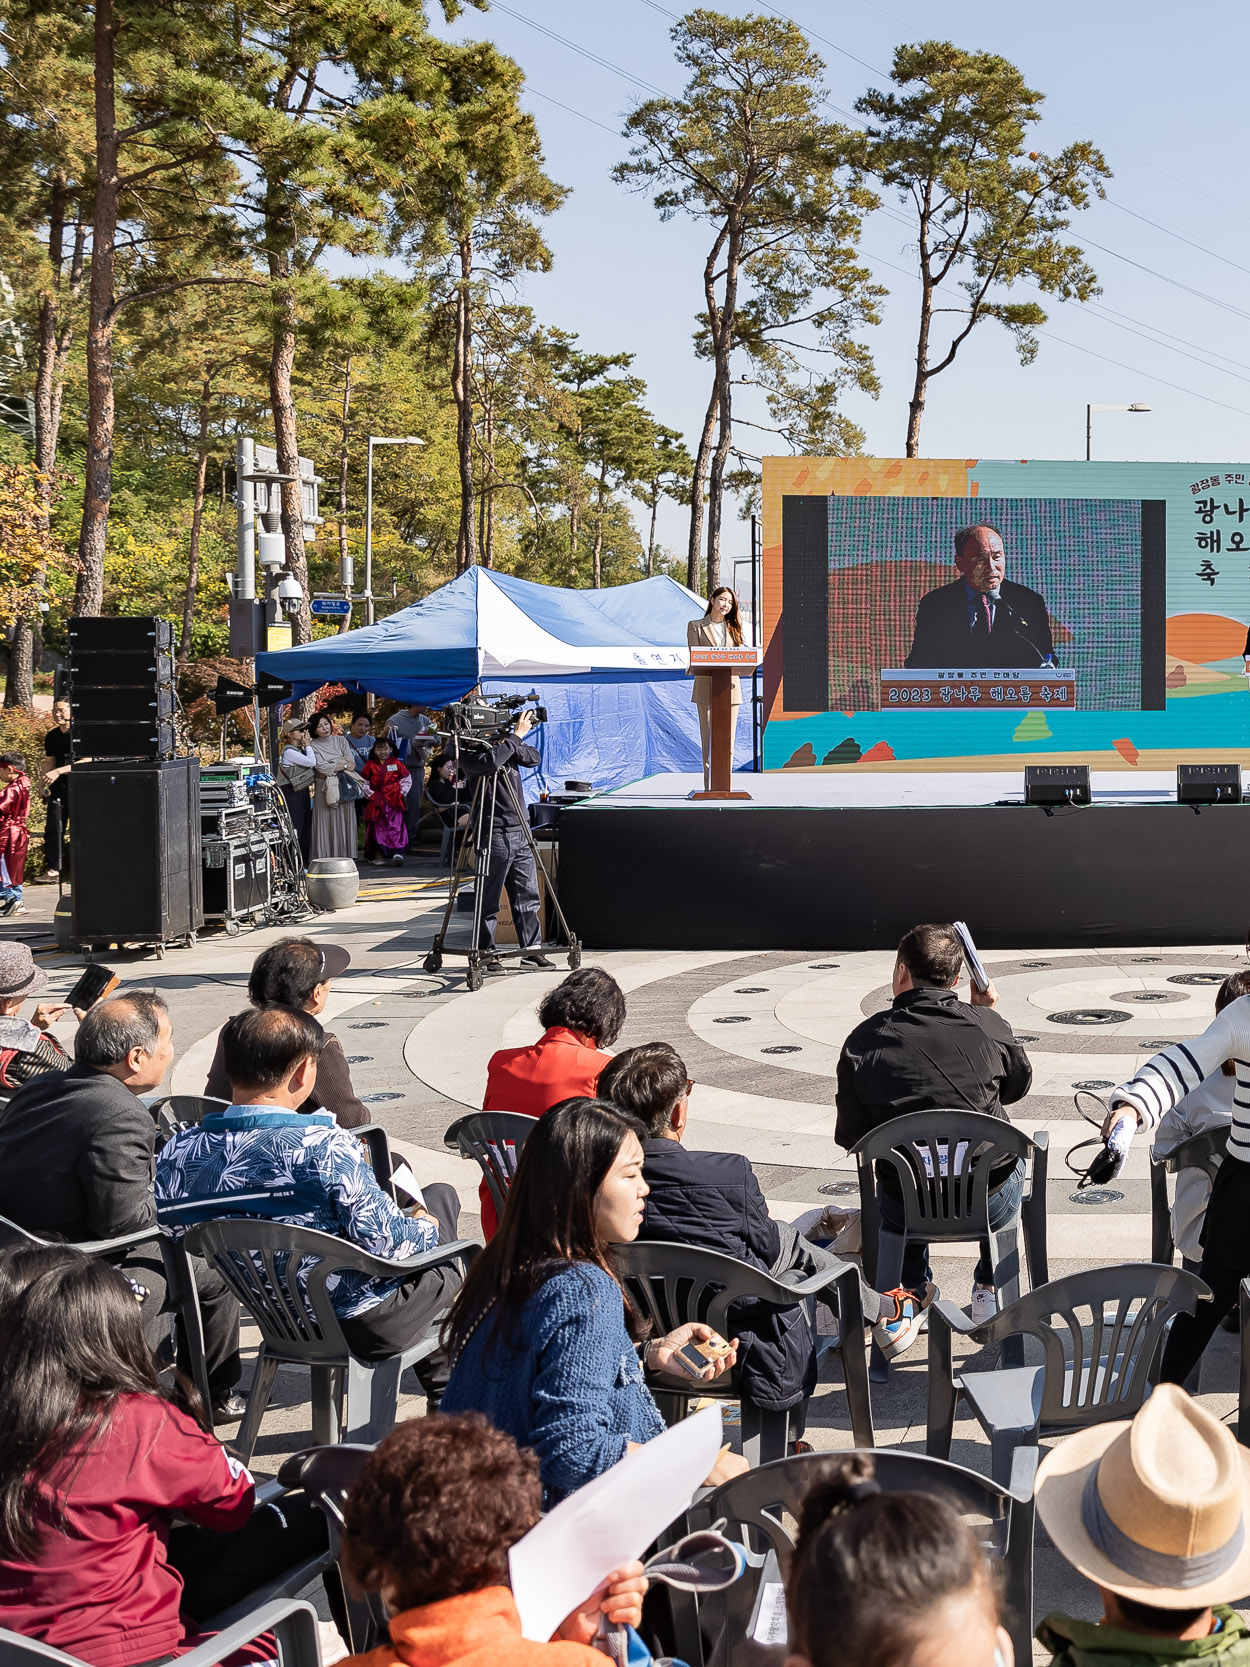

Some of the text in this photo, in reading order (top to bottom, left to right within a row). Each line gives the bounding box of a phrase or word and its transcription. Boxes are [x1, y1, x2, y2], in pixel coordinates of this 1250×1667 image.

[1190, 475, 1221, 495] 광장동
[1224, 473, 1245, 485] 주민
[888, 686, 1068, 703] 2023 광나루 해오름 축제
